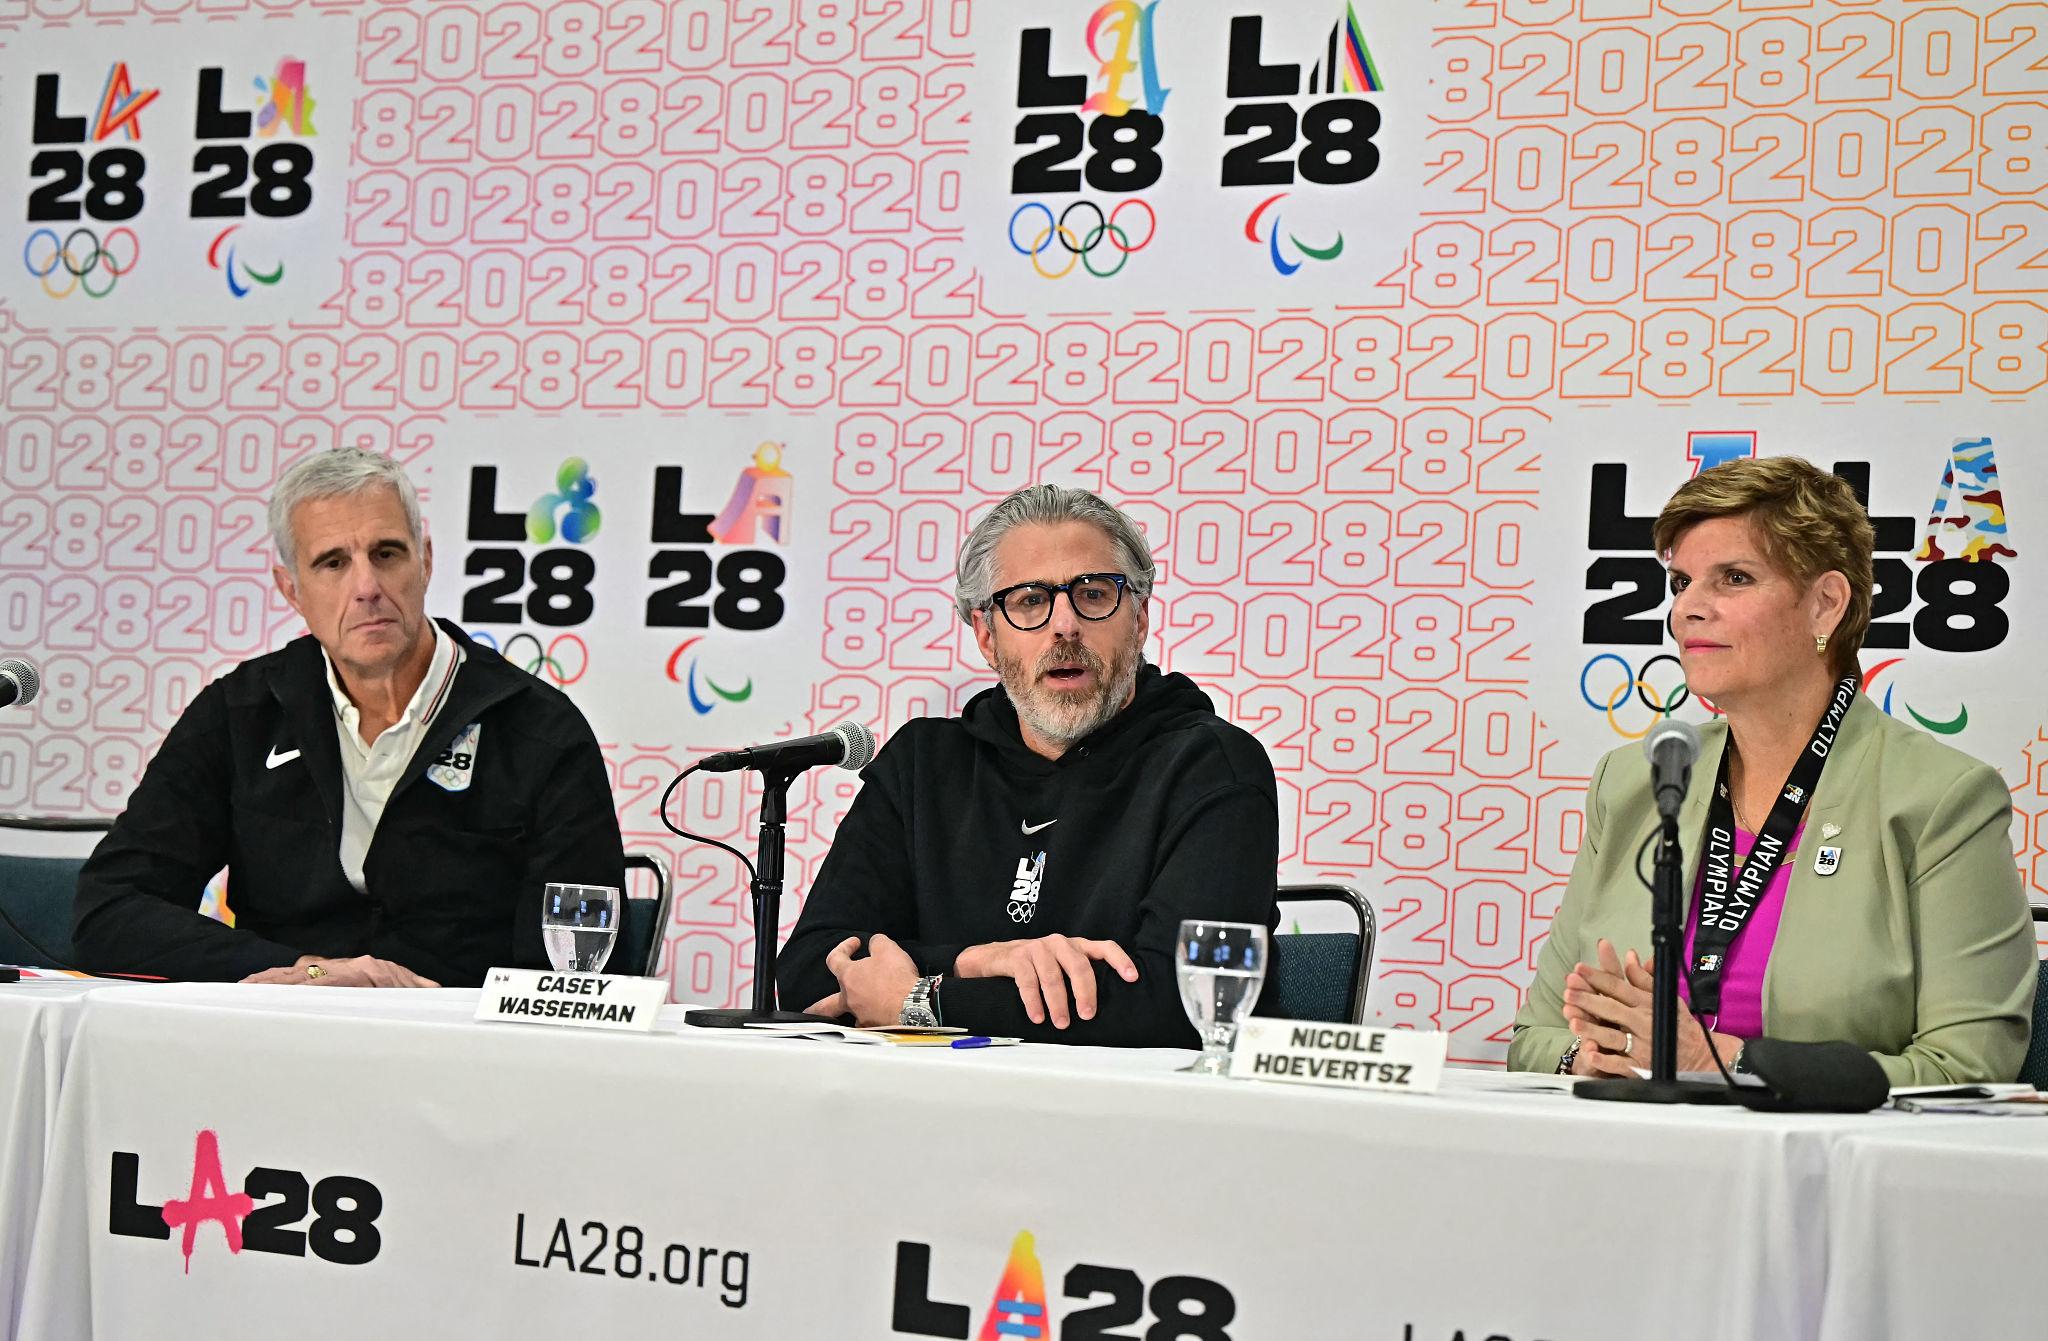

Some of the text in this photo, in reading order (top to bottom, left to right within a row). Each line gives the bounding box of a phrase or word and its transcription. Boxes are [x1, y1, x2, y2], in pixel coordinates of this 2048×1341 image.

[1017, 0, 1172, 116] LA
[1227, 0, 1384, 98] LA
[32, 61, 160, 144] LA
[195, 55, 317, 139] LA
[27, 148, 146, 222] 28
[190, 142, 314, 218] 28
[1011, 110, 1164, 194] 28
[1221, 99, 1382, 187] 28
[651, 441, 793, 545] LA
[461, 548, 596, 626] 28
[645, 549, 787, 631] 28
[1811, 672, 1857, 757] OLYMPIA
[1010, 880, 1040, 903] 28
[1701, 827, 1731, 926] OLYMPIAN
[1718, 833, 1783, 931] OLYMPIAN
[1819, 857, 1835, 865] 28
[498, 996, 636, 1023] WASSERMAN
[537, 975, 612, 996] CASEY
[1253, 1054, 1413, 1084] HOEVERTSZ
[1290, 1028, 1386, 1053] NICOLE
[109, 1129, 382, 1275] LA28
[513, 1213, 750, 1308] LA28.org
[892, 1230, 1236, 1341] LA28
